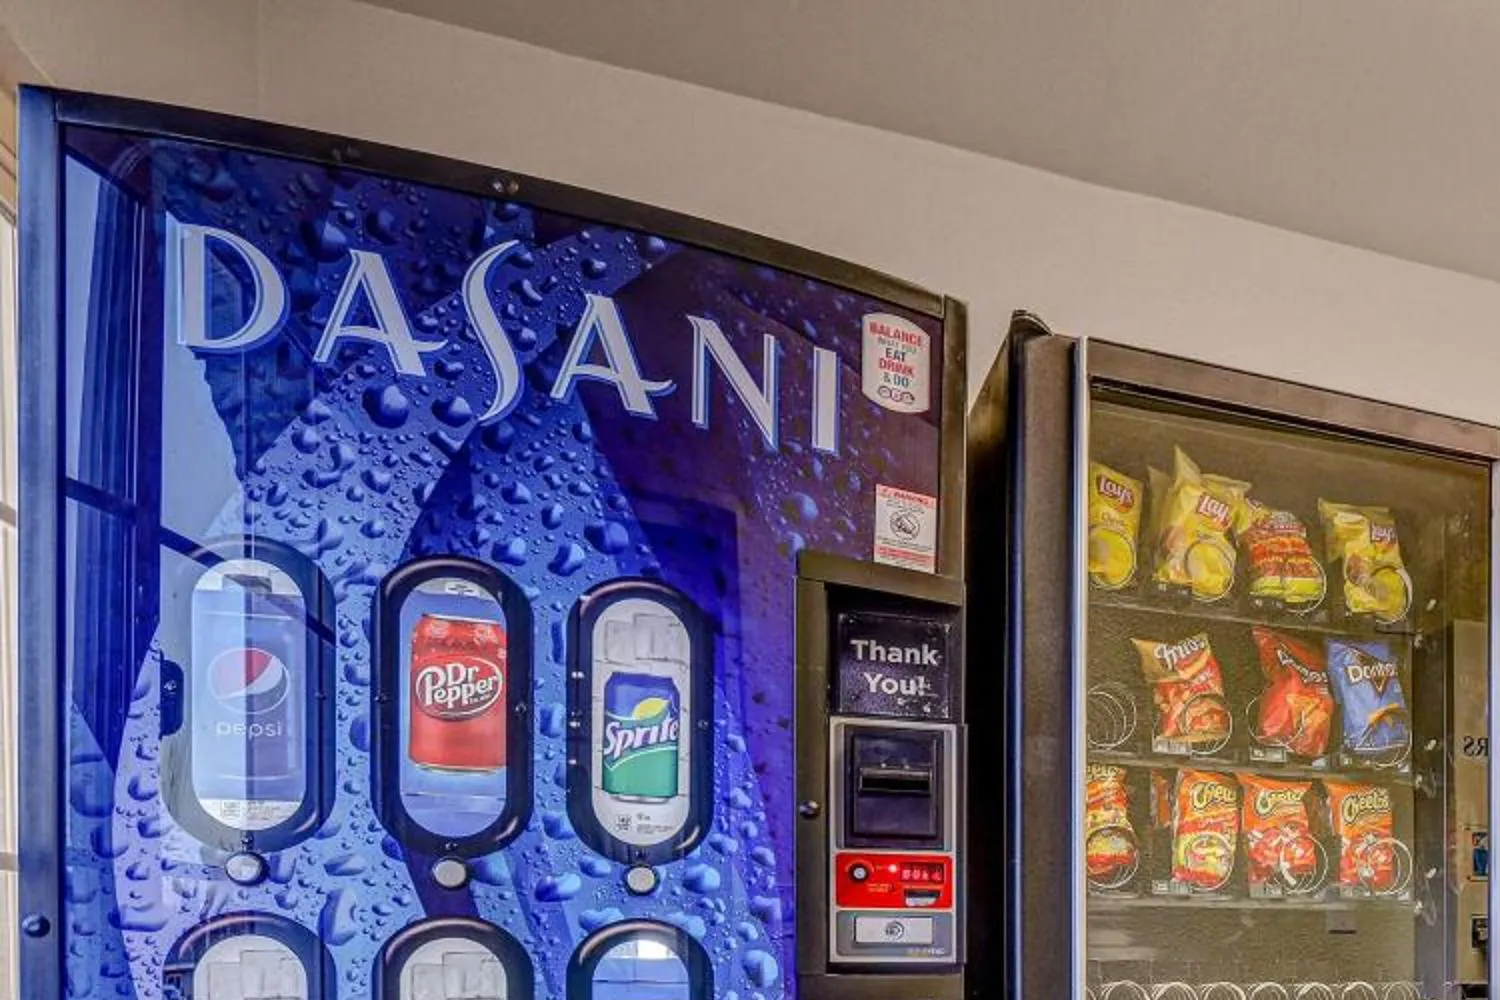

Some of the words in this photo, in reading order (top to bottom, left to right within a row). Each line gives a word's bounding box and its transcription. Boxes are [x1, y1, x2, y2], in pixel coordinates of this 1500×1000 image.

[164, 208, 842, 456] DASANI
[869, 321, 923, 347] BALANCE
[885, 347, 906, 362] EAT
[878, 358, 915, 378] DRINK
[850, 638, 938, 666] Thank
[421, 664, 498, 709] Pepper
[446, 662, 480, 687] Dr
[863, 672, 926, 697] You!
[216, 719, 282, 740] pepsi
[604, 716, 679, 761] Sprite
